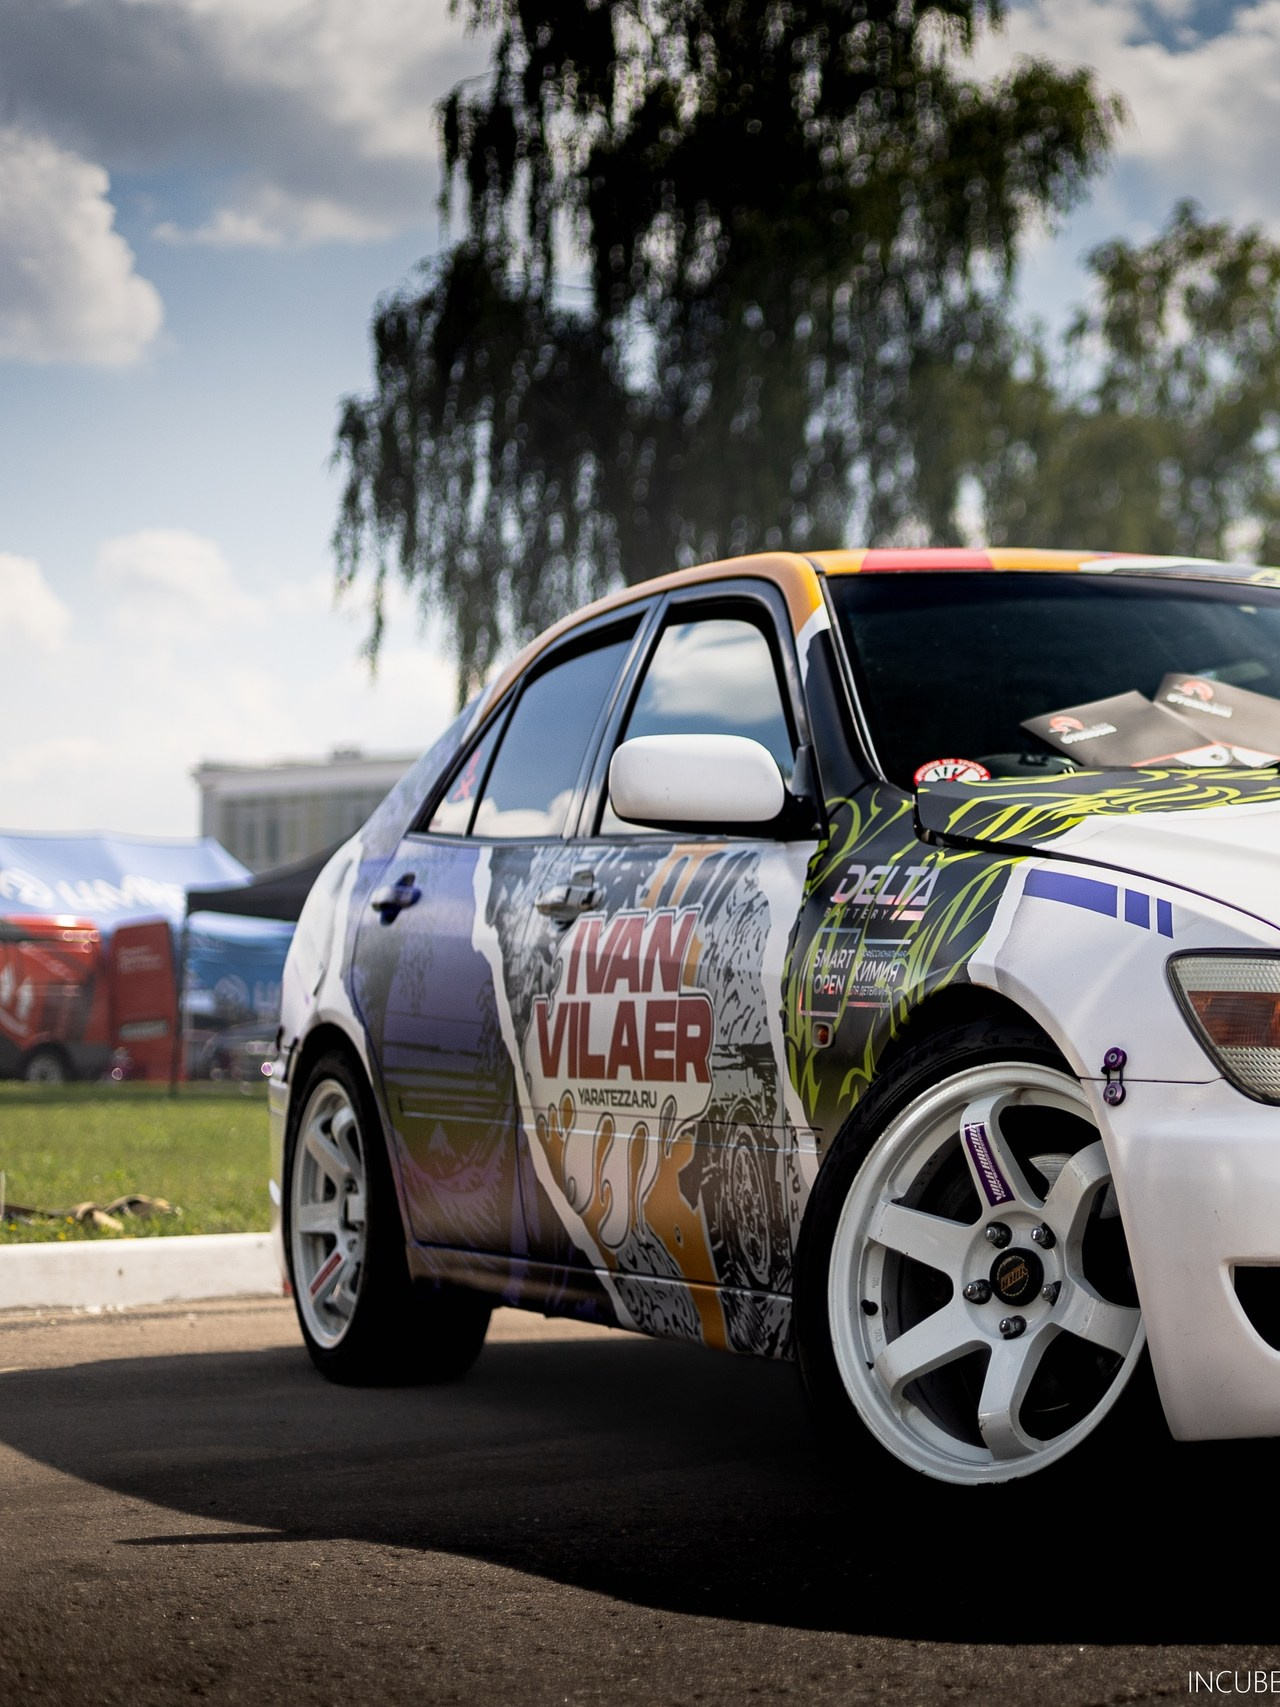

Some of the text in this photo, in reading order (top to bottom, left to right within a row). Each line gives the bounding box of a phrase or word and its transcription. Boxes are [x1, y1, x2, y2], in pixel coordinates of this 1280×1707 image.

[830, 864, 940, 905] DELTA
[824, 907, 889, 920] BATTERY
[567, 913, 698, 995] IVAN
[813, 948, 855, 969] SMART
[813, 975, 845, 995] OPEN
[536, 999, 712, 1083] VILAER
[578, 1088, 657, 1108] YARATEZZA.RU
